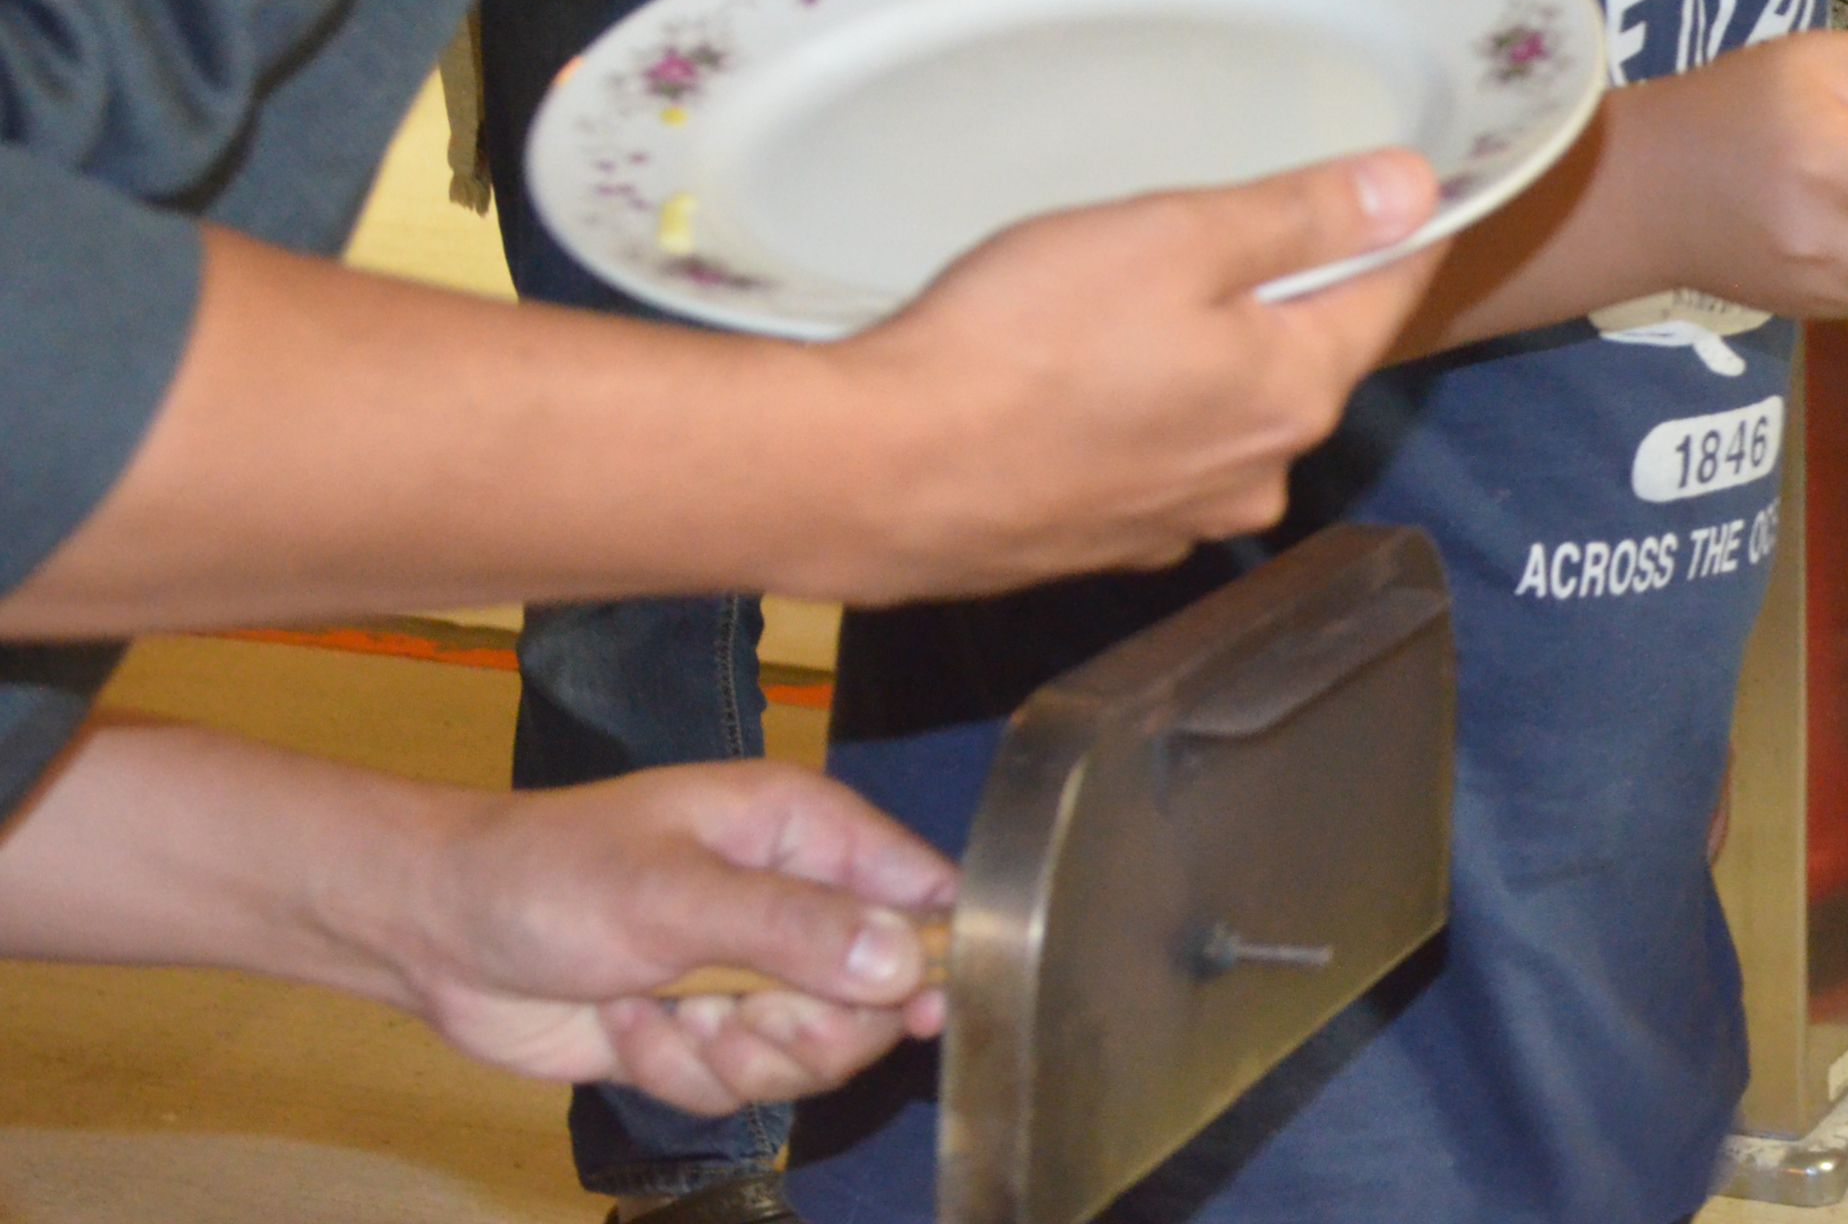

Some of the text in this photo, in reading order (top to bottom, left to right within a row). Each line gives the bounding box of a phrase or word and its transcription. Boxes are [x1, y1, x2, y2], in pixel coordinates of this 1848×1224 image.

[1675, 415, 1768, 489] 1846
[1514, 532, 1678, 599] ACROSS
[1687, 519, 1745, 580] THE
